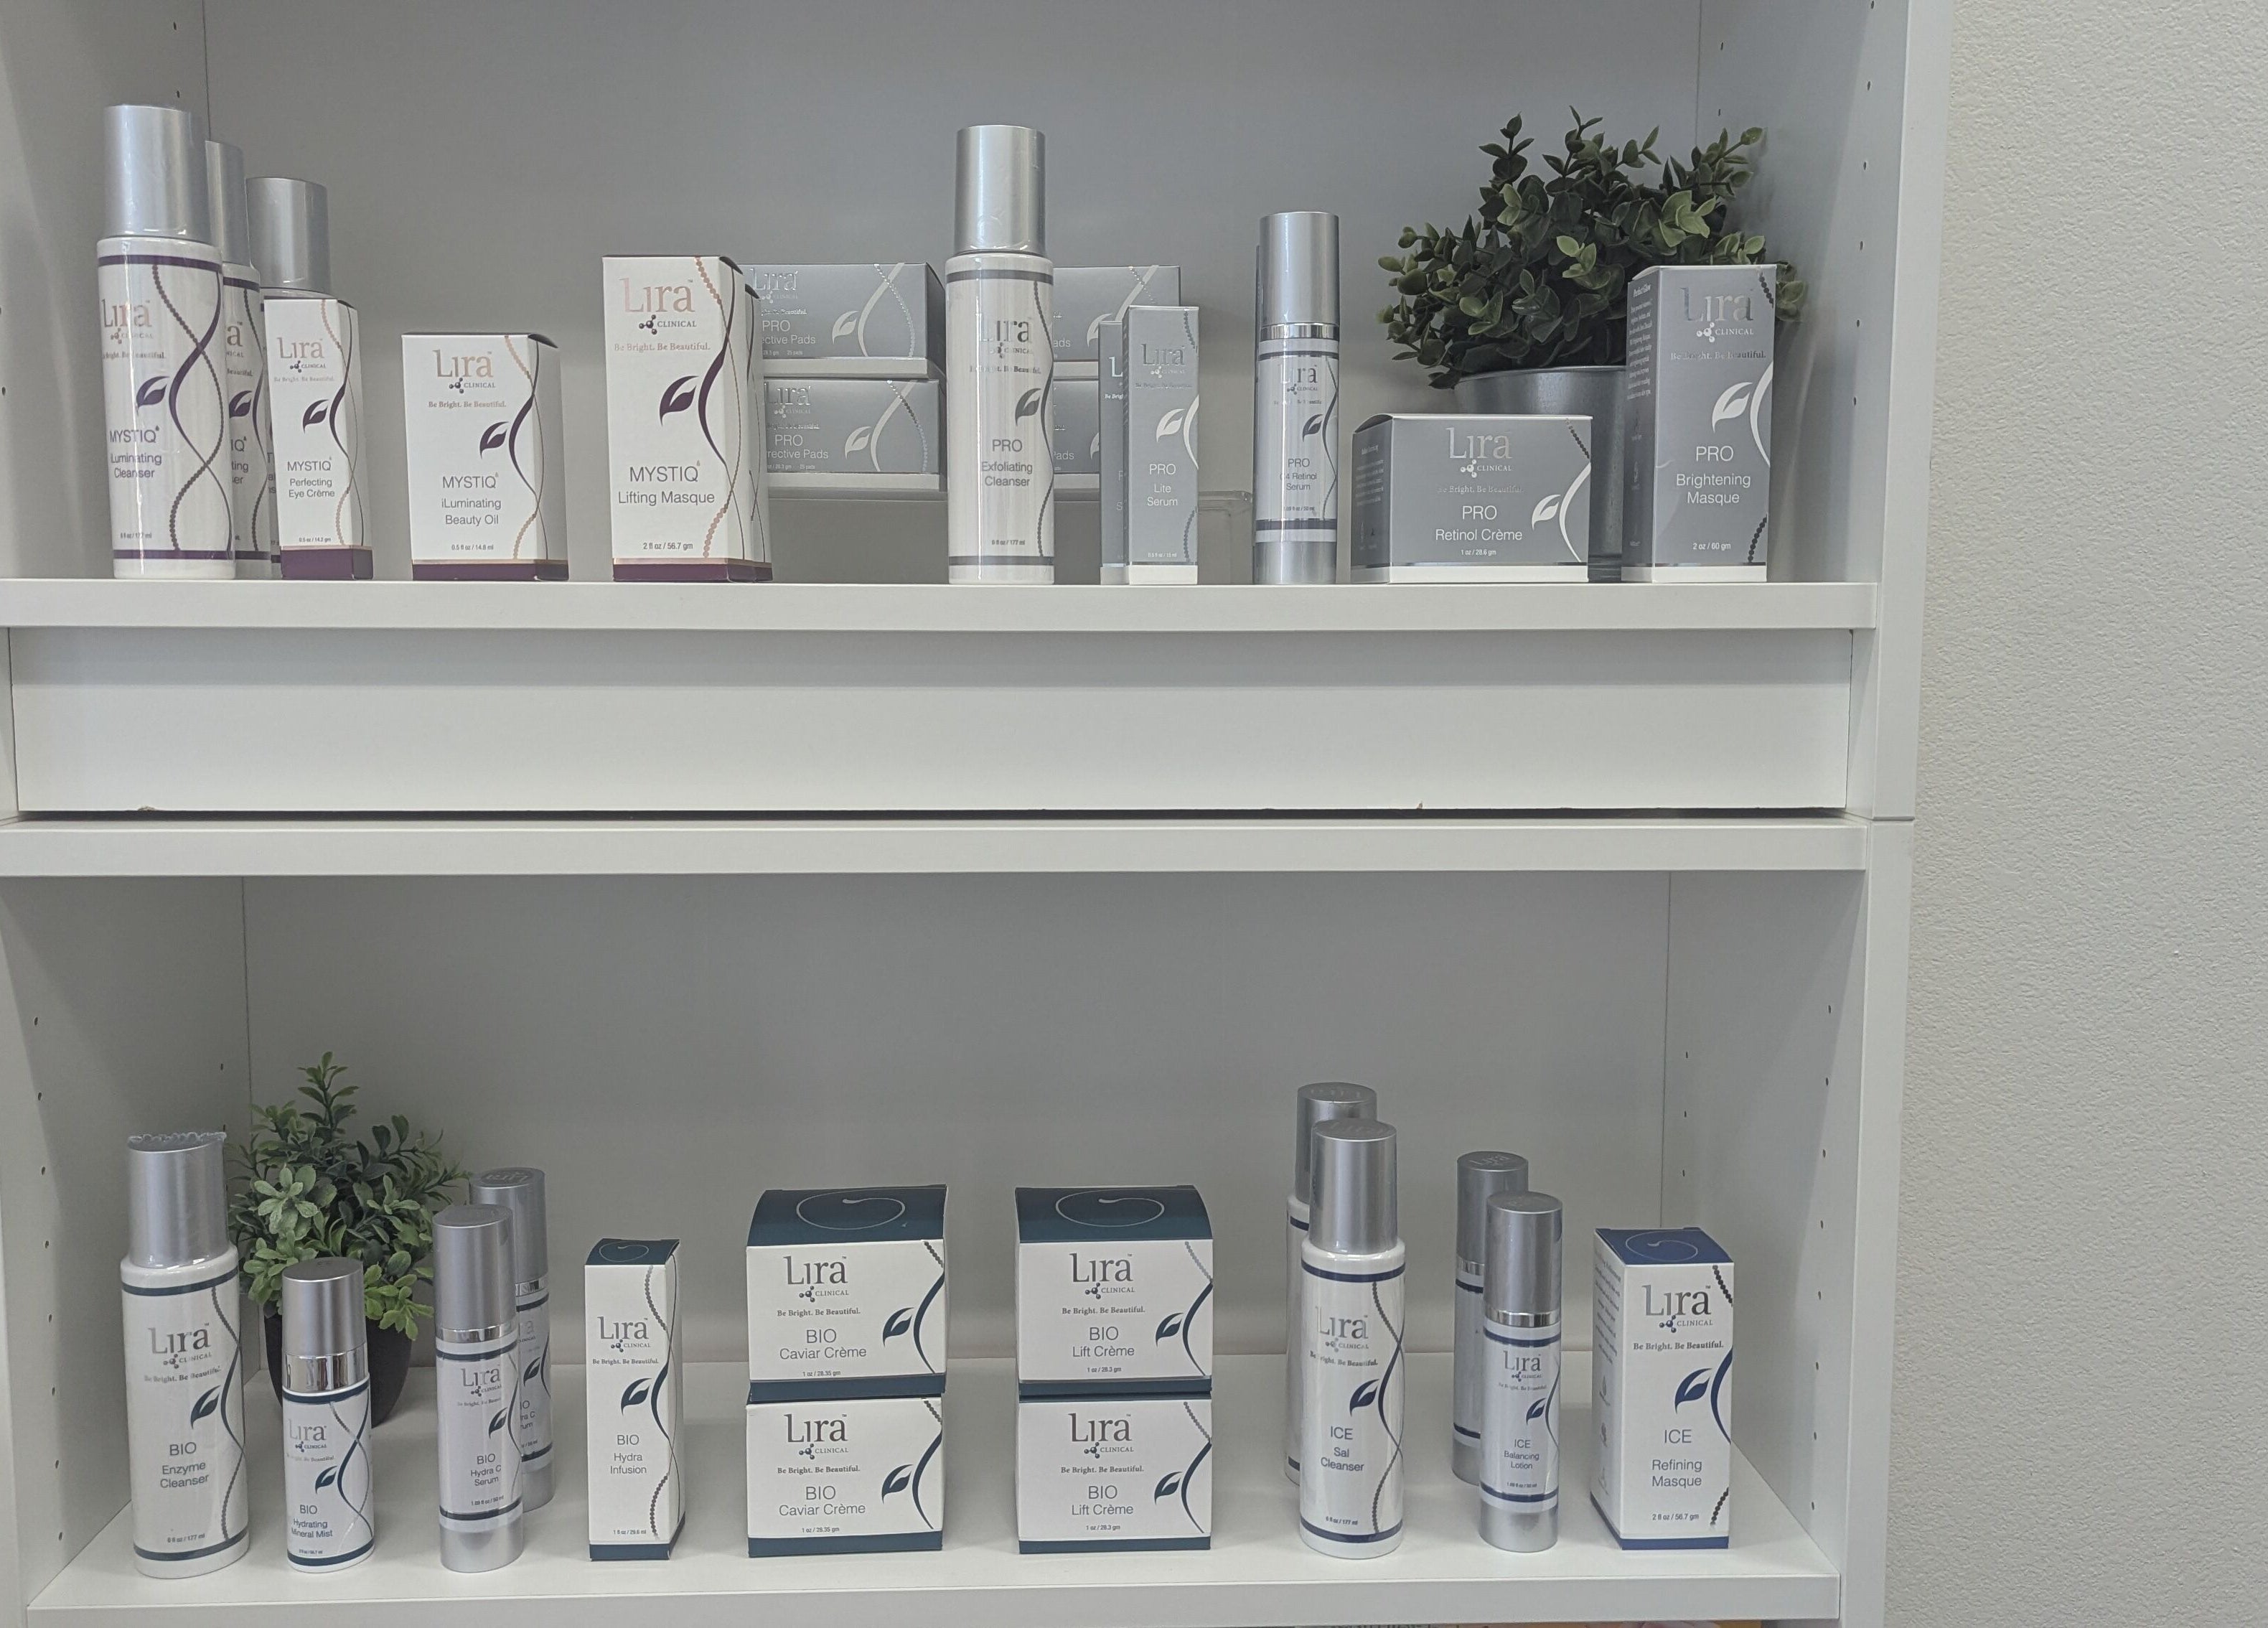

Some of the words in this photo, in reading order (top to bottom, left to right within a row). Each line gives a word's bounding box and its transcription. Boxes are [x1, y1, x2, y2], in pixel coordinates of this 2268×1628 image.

[1680, 287, 1754, 322] Lira
[762, 319, 791, 332] PRO
[791, 335, 816, 345] Pads
[670, 342, 711, 351] Beautiful.
[439, 401, 462, 410] Bright.
[774, 434, 803, 446] PRO
[992, 439, 1023, 452] PRO
[1445, 427, 1512, 459] Lira
[803, 449, 829, 459] Pads
[1696, 445, 1734, 462] PRO
[287, 461, 331, 472] MYSTIQ
[981, 462, 1033, 474] Exfoliating
[1288, 458, 1311, 468] PRO
[114, 467, 155, 478] Cleanser
[629, 466, 698, 482] MYSTIQ
[1148, 464, 1176, 475] PRO
[442, 475, 496, 489] MYSTIQ
[984, 475, 1031, 487] Cleanser
[1292, 472, 1317, 480] Retinol
[1677, 473, 1751, 489] Brightening
[289, 478, 332, 488] Perfecting
[1154, 484, 1171, 493] Lite
[1286, 482, 1311, 491] Serum
[289, 490, 305, 499] Eye
[306, 488, 335, 497] Crème
[1449, 486, 1475, 495] Bright.
[441, 498, 502, 510] iLuminating
[618, 491, 657, 506] Lifting
[661, 491, 715, 505] Masque
[1147, 497, 1178, 506] Serum
[1687, 492, 1740, 506] Masque
[1462, 505, 1497, 520] PRO
[446, 515, 482, 526] Beauty
[485, 515, 499, 524] Oil
[1435, 528, 1477, 541] Retinol
[1481, 528, 1523, 541] Crème
[788, 1309, 814, 1319] Bright.
[826, 1307, 861, 1316] Beautiful.
[1073, 1307, 1097, 1316] Bright.
[597, 1316, 649, 1340] Lira
[1089, 1326, 1119, 1341] BIO
[147, 1327, 211, 1355] Lira
[807, 1329, 837, 1344] BIO
[1072, 1346, 1091, 1357] Lift
[1094, 1345, 1135, 1357] Crème
[1645, 1342, 1673, 1352] Bright.
[1687, 1340, 1725, 1349] Beautiful.
[779, 1347, 820, 1360] Caviar
[825, 1346, 867, 1358] Crème
[1330, 1426, 1353, 1440] ICE
[1664, 1429, 1692, 1444] ICE
[617, 1435, 639, 1446] BIO
[1514, 1439, 1531, 1449] ICE
[169, 1441, 197, 1456] BIO
[1334, 1446, 1349, 1458] Sal
[477, 1453, 496, 1465] BIO
[614, 1452, 643, 1464] Hydra
[1504, 1451, 1540, 1460] Balancing
[161, 1461, 206, 1476] Enzyme
[610, 1466, 647, 1474] Infusion
[1321, 1456, 1364, 1472] Cleanser
[1652, 1459, 1702, 1472] Refining
[470, 1466, 495, 1478] Hydra
[495, 1464, 502, 1473] C
[788, 1466, 813, 1475] Bright.
[160, 1473, 210, 1488] Cleanser
[474, 1476, 499, 1487] Serum
[1652, 1476, 1702, 1487] Masque
[806, 1485, 836, 1501] BIO
[1088, 1484, 1118, 1500] BIO
[299, 1504, 318, 1515] BIO
[779, 1504, 820, 1517] Caviar
[824, 1502, 866, 1515] Crème
[1072, 1504, 1090, 1516] Lift
[1093, 1503, 1134, 1515] Crème
[293, 1518, 328, 1529] Hydrating
[291, 1528, 314, 1538] Mineral
[316, 1529, 333, 1538] Mist
